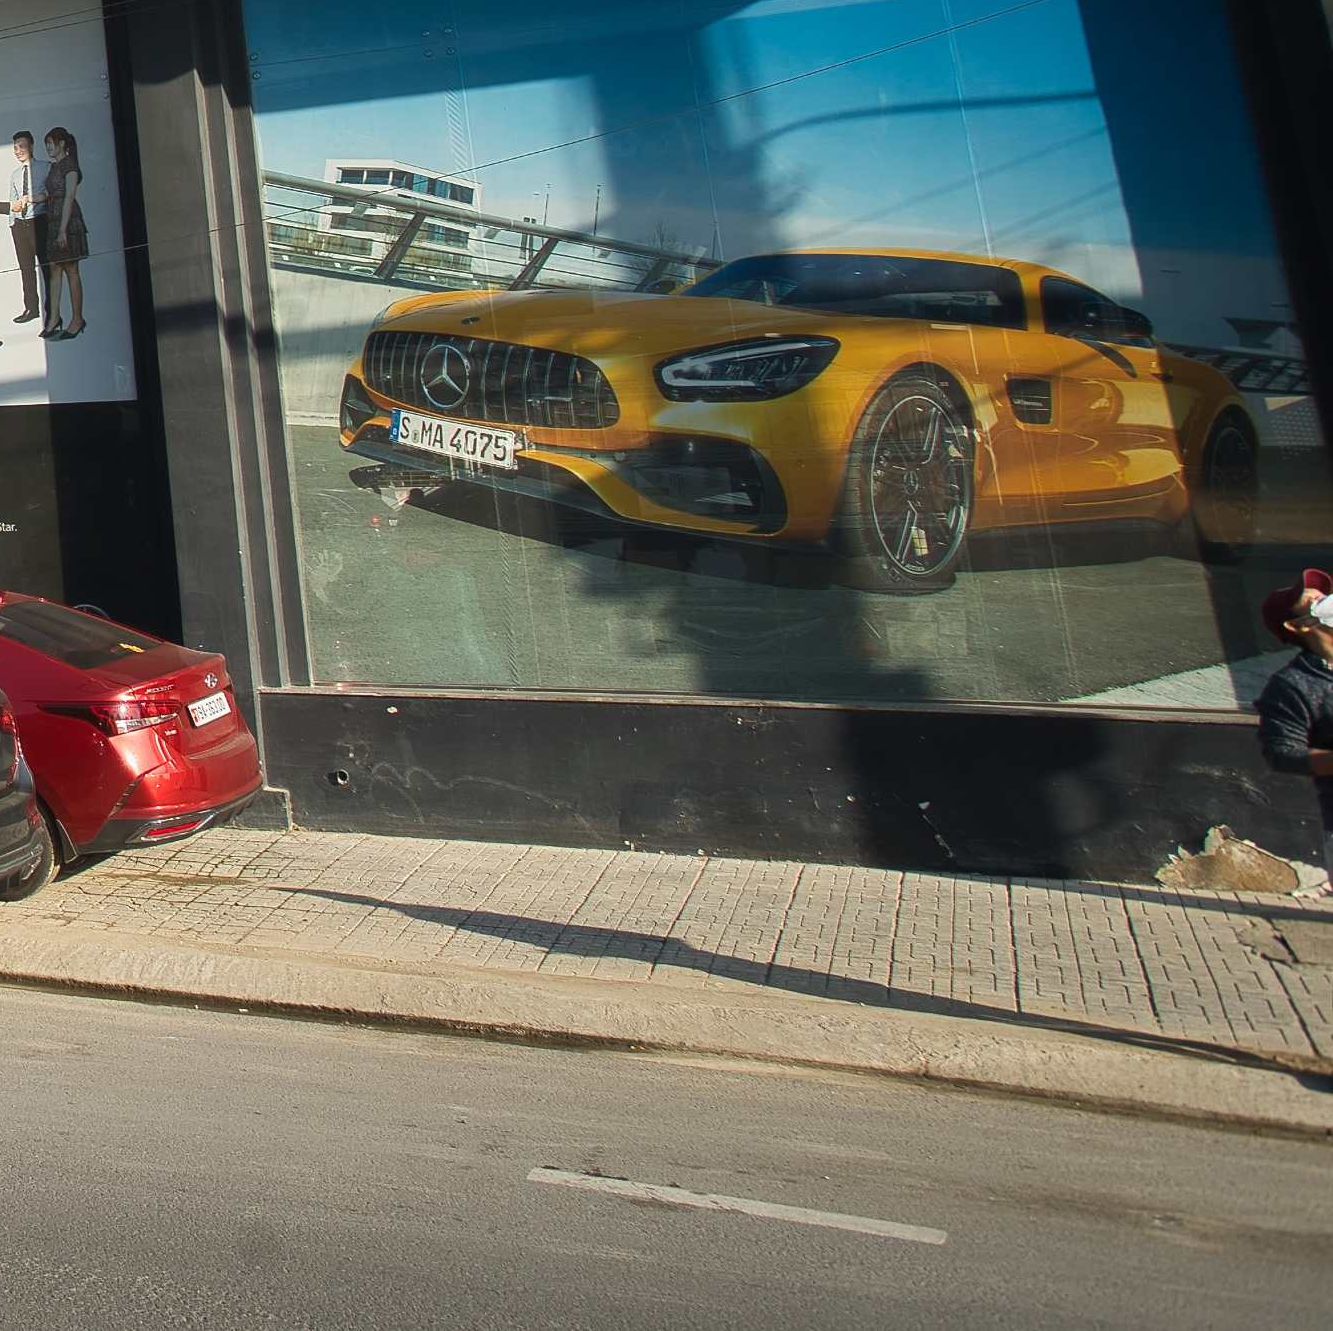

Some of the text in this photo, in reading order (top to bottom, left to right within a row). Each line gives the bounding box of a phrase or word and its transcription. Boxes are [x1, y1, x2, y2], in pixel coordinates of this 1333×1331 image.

[400, 416, 507, 462] S MA 4075
